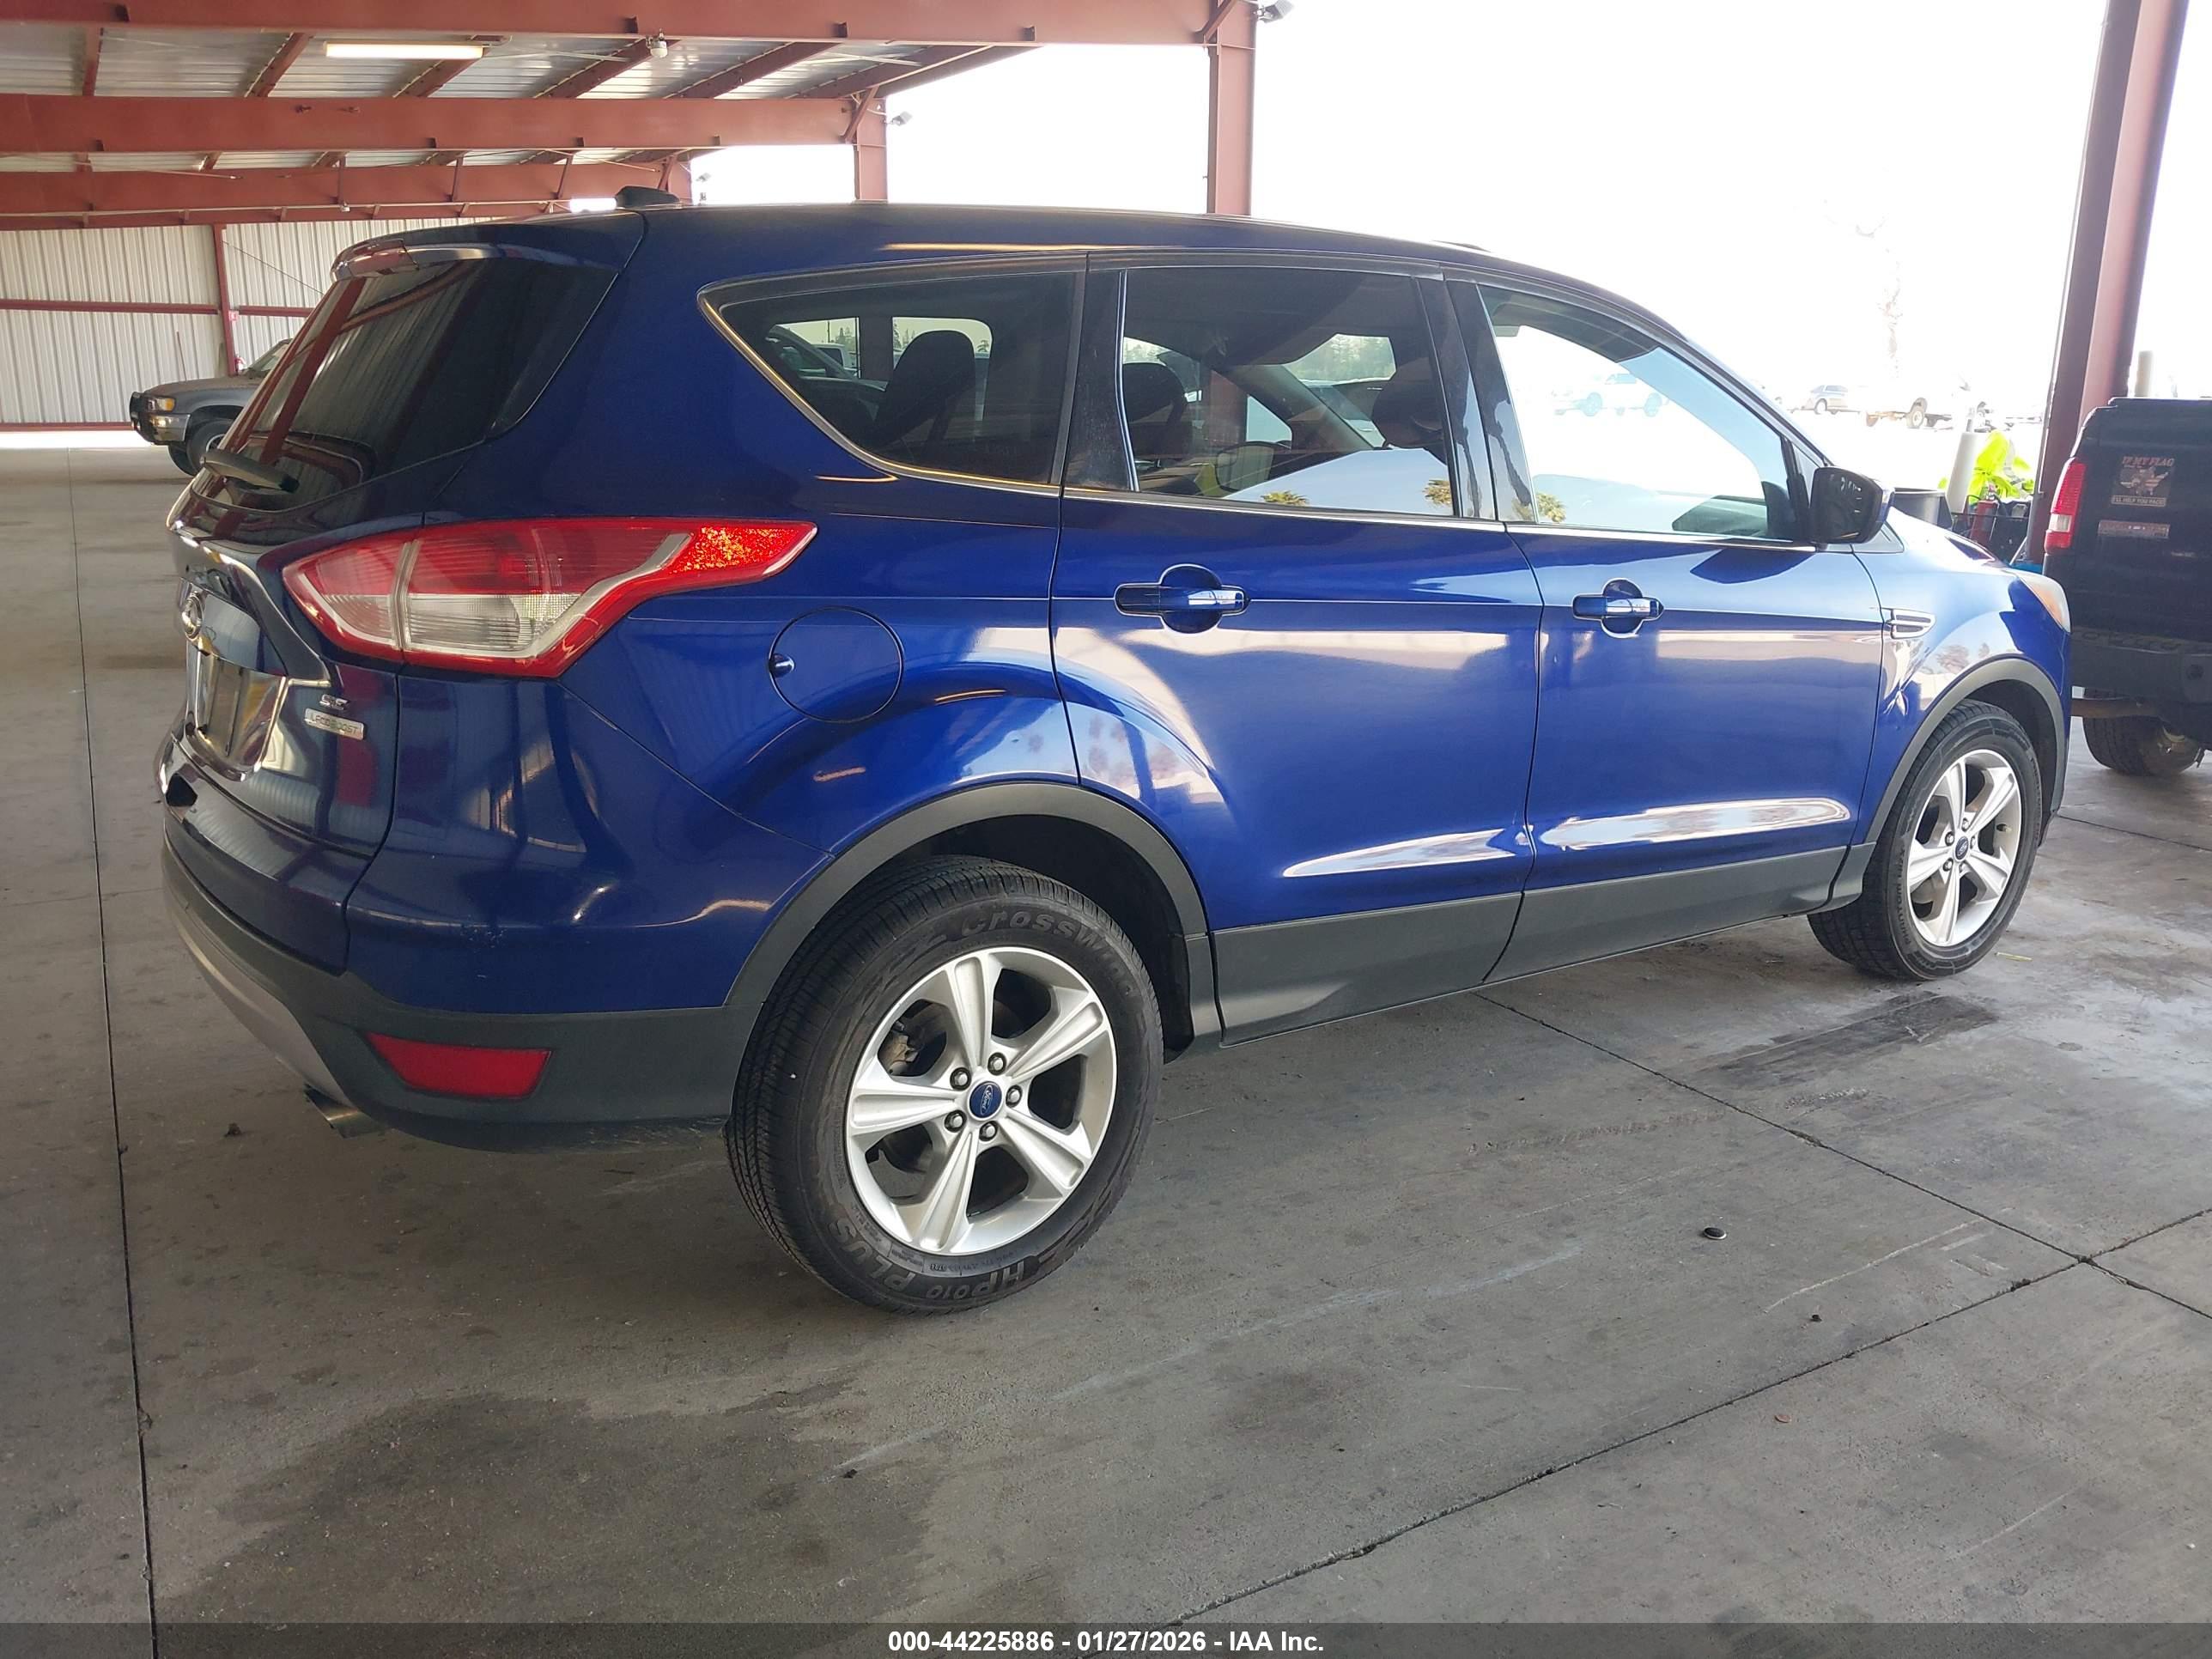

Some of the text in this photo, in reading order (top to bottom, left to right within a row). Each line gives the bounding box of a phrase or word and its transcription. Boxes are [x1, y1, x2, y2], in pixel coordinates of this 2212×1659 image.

[2133, 456, 2149, 465] MY
[2149, 457, 2175, 467] FLAG
[830, 1217, 916, 1291] PLUS
